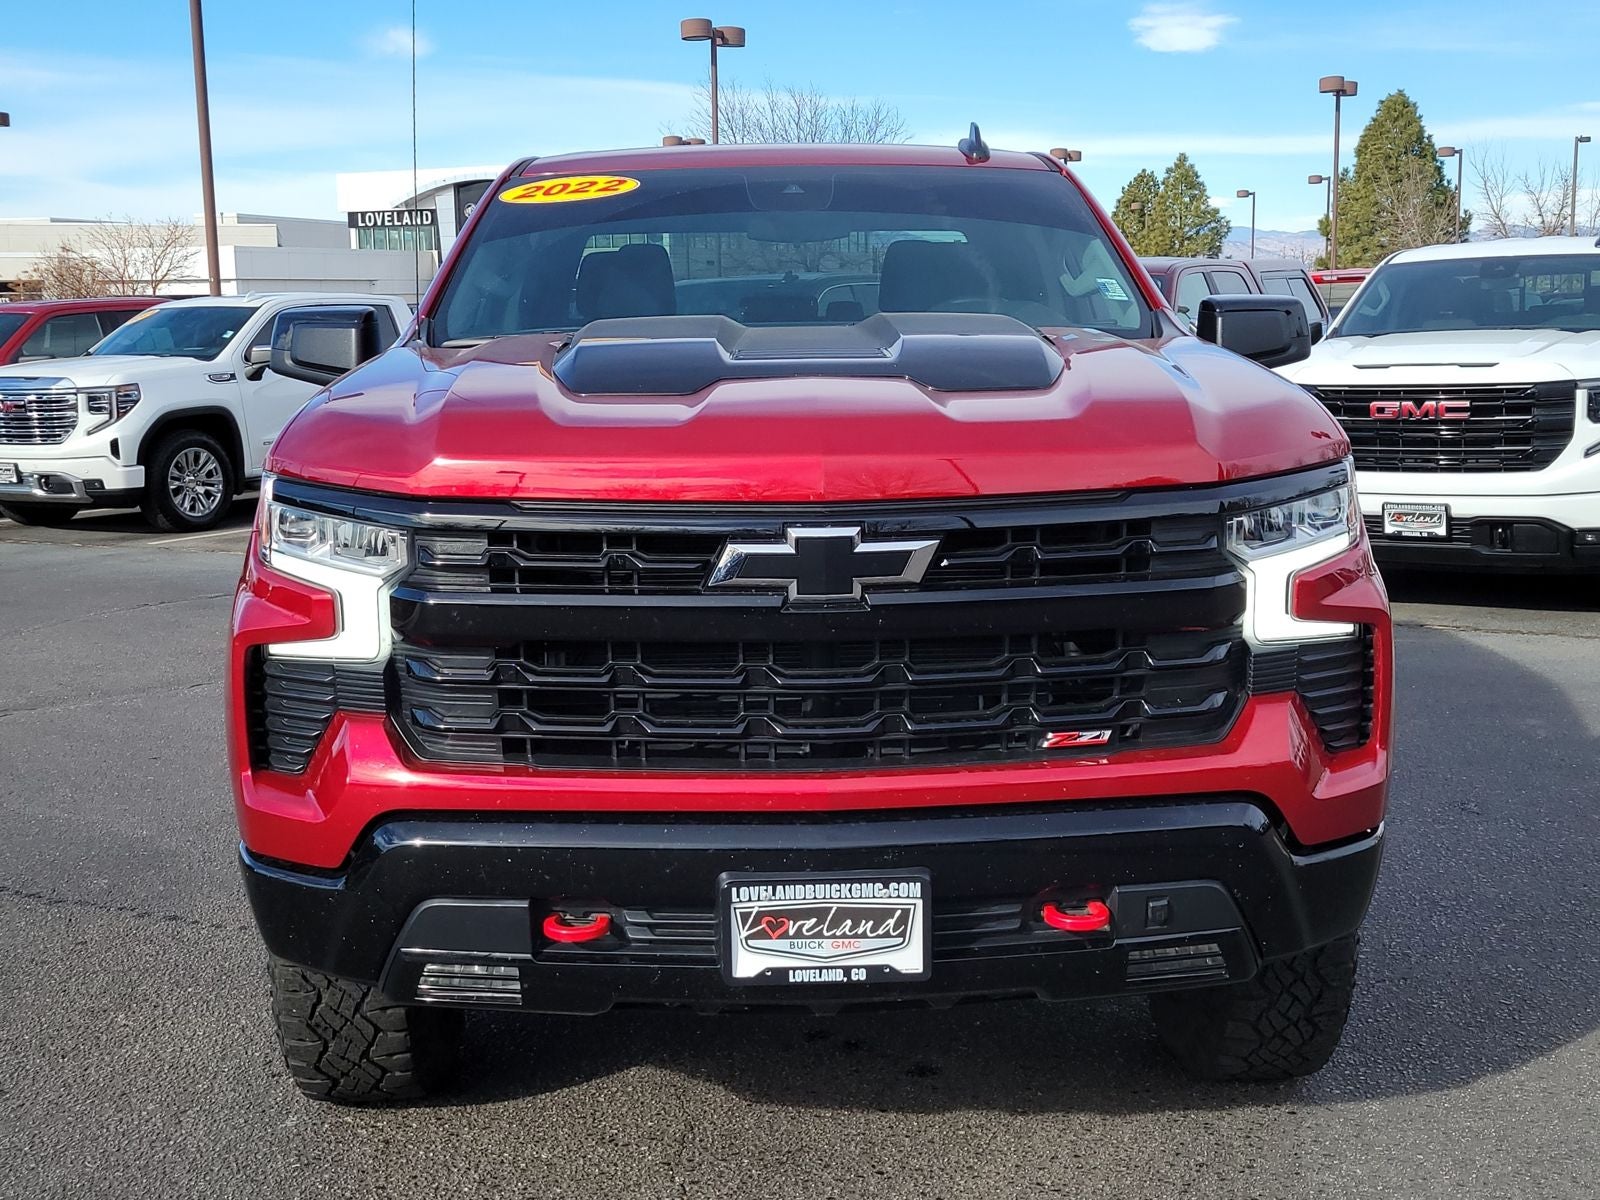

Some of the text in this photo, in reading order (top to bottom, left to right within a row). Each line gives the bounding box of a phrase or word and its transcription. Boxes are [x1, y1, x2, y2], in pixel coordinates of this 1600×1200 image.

[512, 179, 628, 200] 2022
[358, 211, 432, 226] LOVELAND
[1369, 400, 1471, 420] GMC
[1042, 729, 1112, 748] Z71
[731, 882, 921, 902] LOVELANDBUICKGMCCOM
[789, 940, 861, 950] BUICK GMC
[789, 968, 866, 982] LOVELAND, CO
